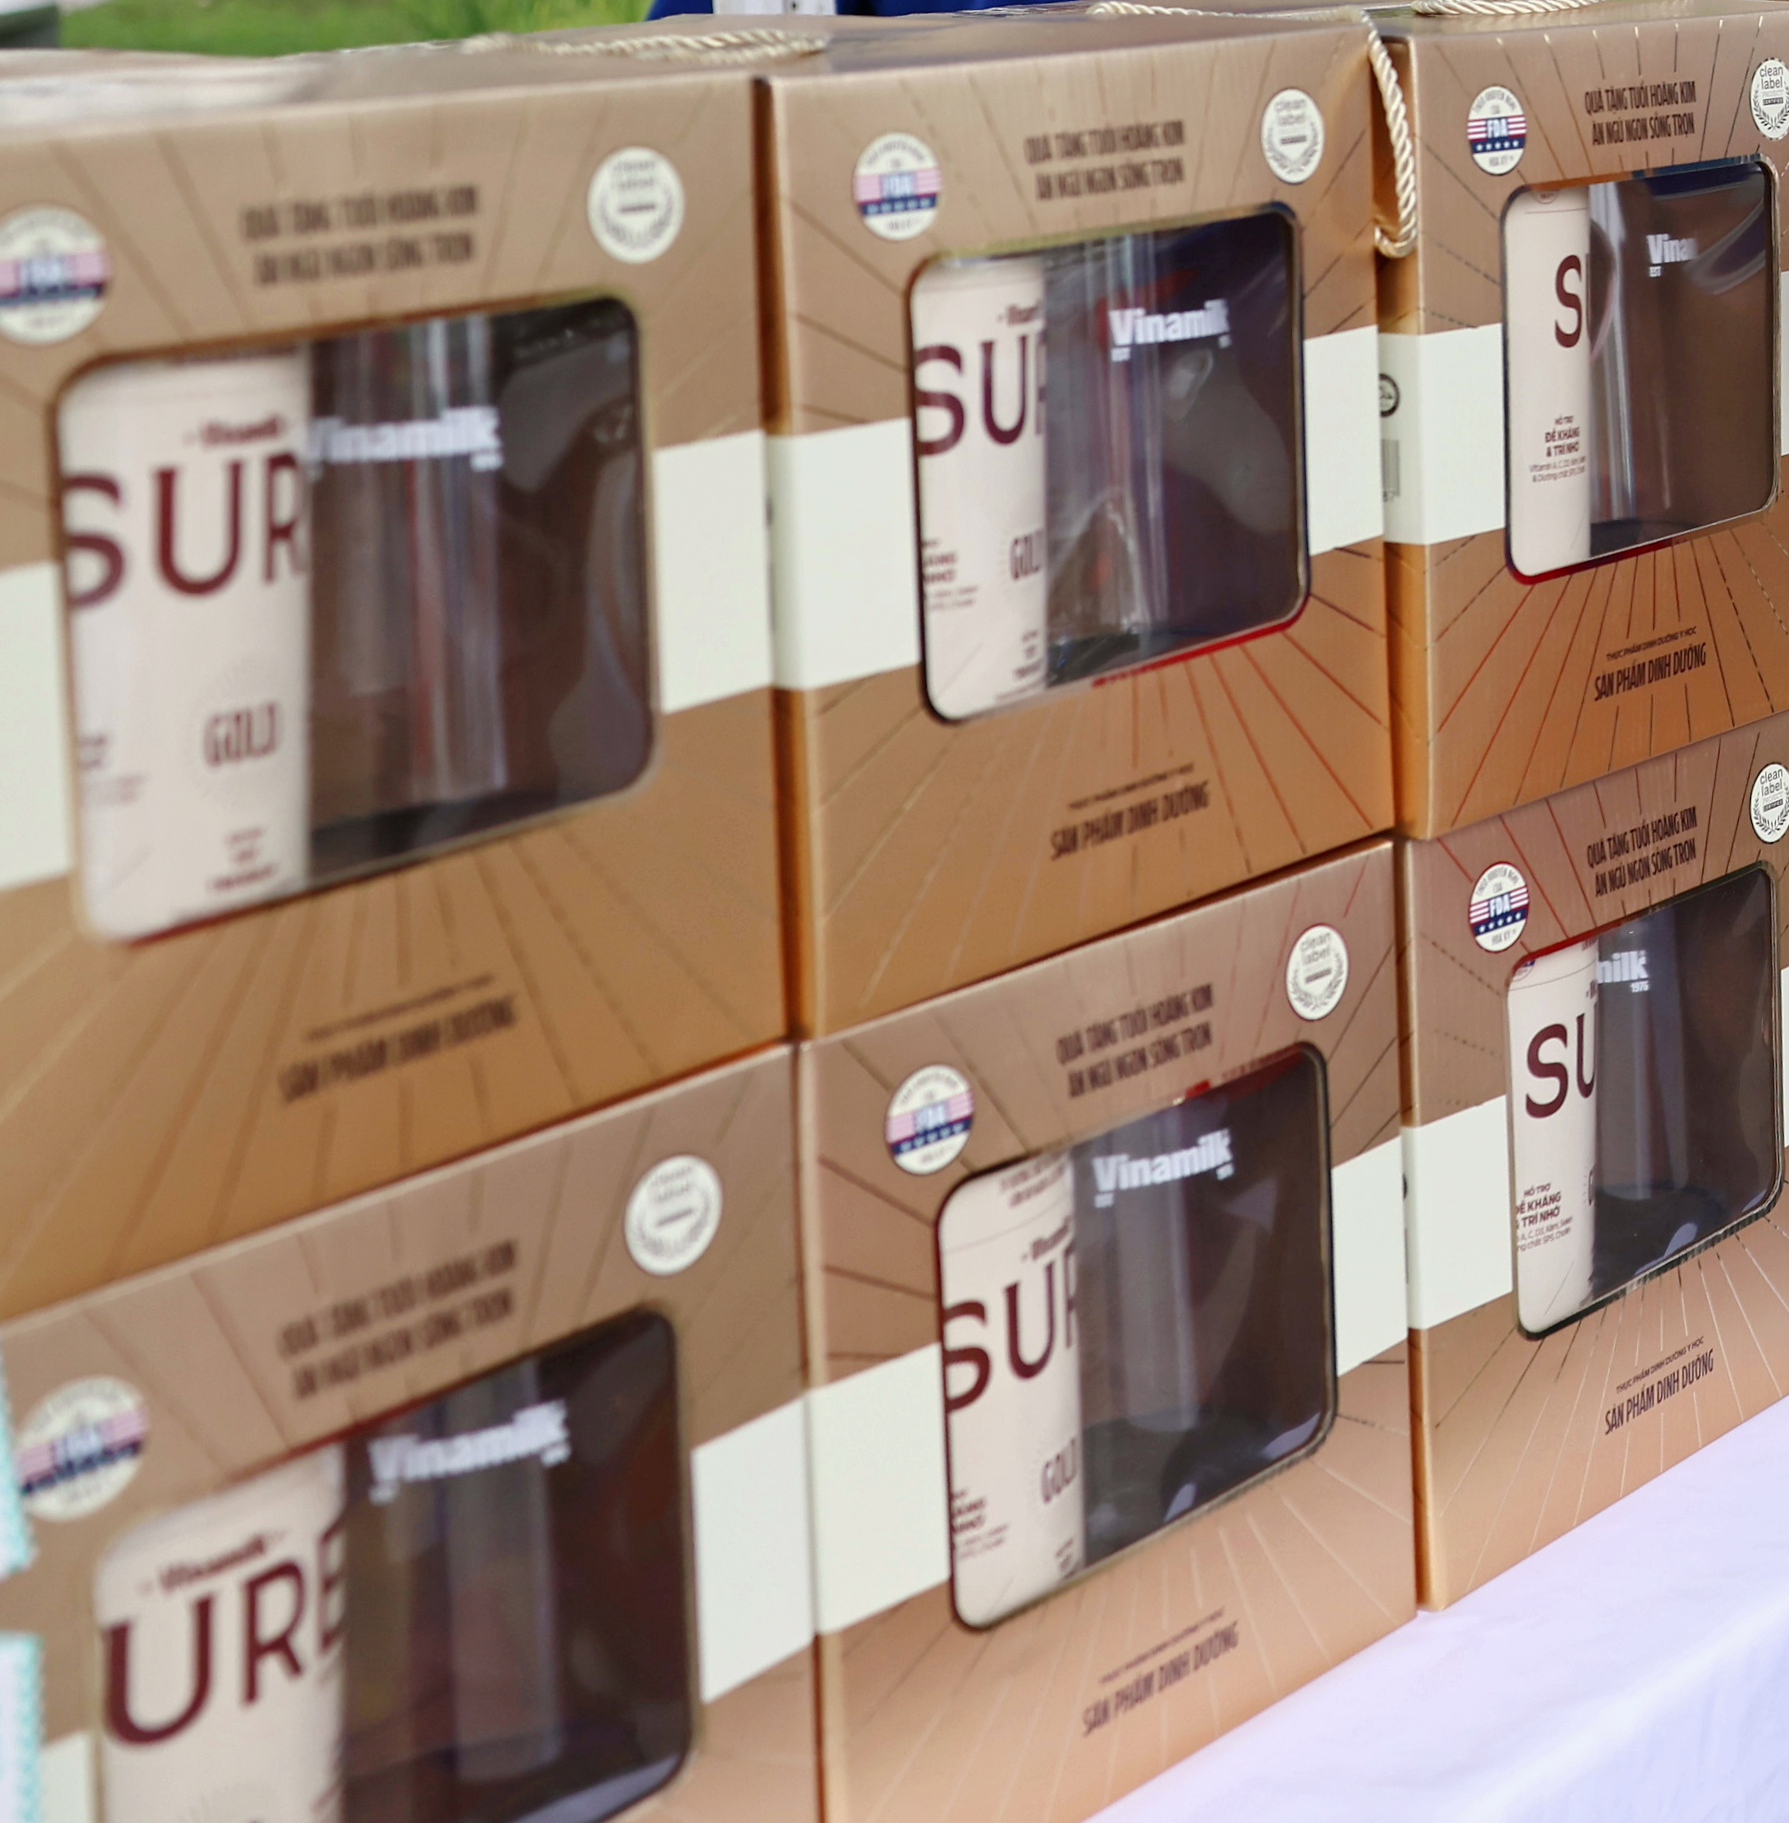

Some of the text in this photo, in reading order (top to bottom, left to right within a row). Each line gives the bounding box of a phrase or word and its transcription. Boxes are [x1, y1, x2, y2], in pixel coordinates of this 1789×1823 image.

[1760, 66, 1783, 77] clean
[1761, 76, 1783, 90] label
[915, 329, 1044, 457] SU
[1617, 659, 1646, 694] PHẨM
[1648, 654, 1671, 684] DINH
[1674, 642, 1706, 675] DƯỠNG
[1760, 769, 1783, 784] clean
[1761, 778, 1782, 796] label
[1490, 894, 1512, 918] FDA
[943, 1247, 1076, 1415] SU
[1605, 1348, 1713, 1435] SẢN PHẨM DINH DƯỠNG
